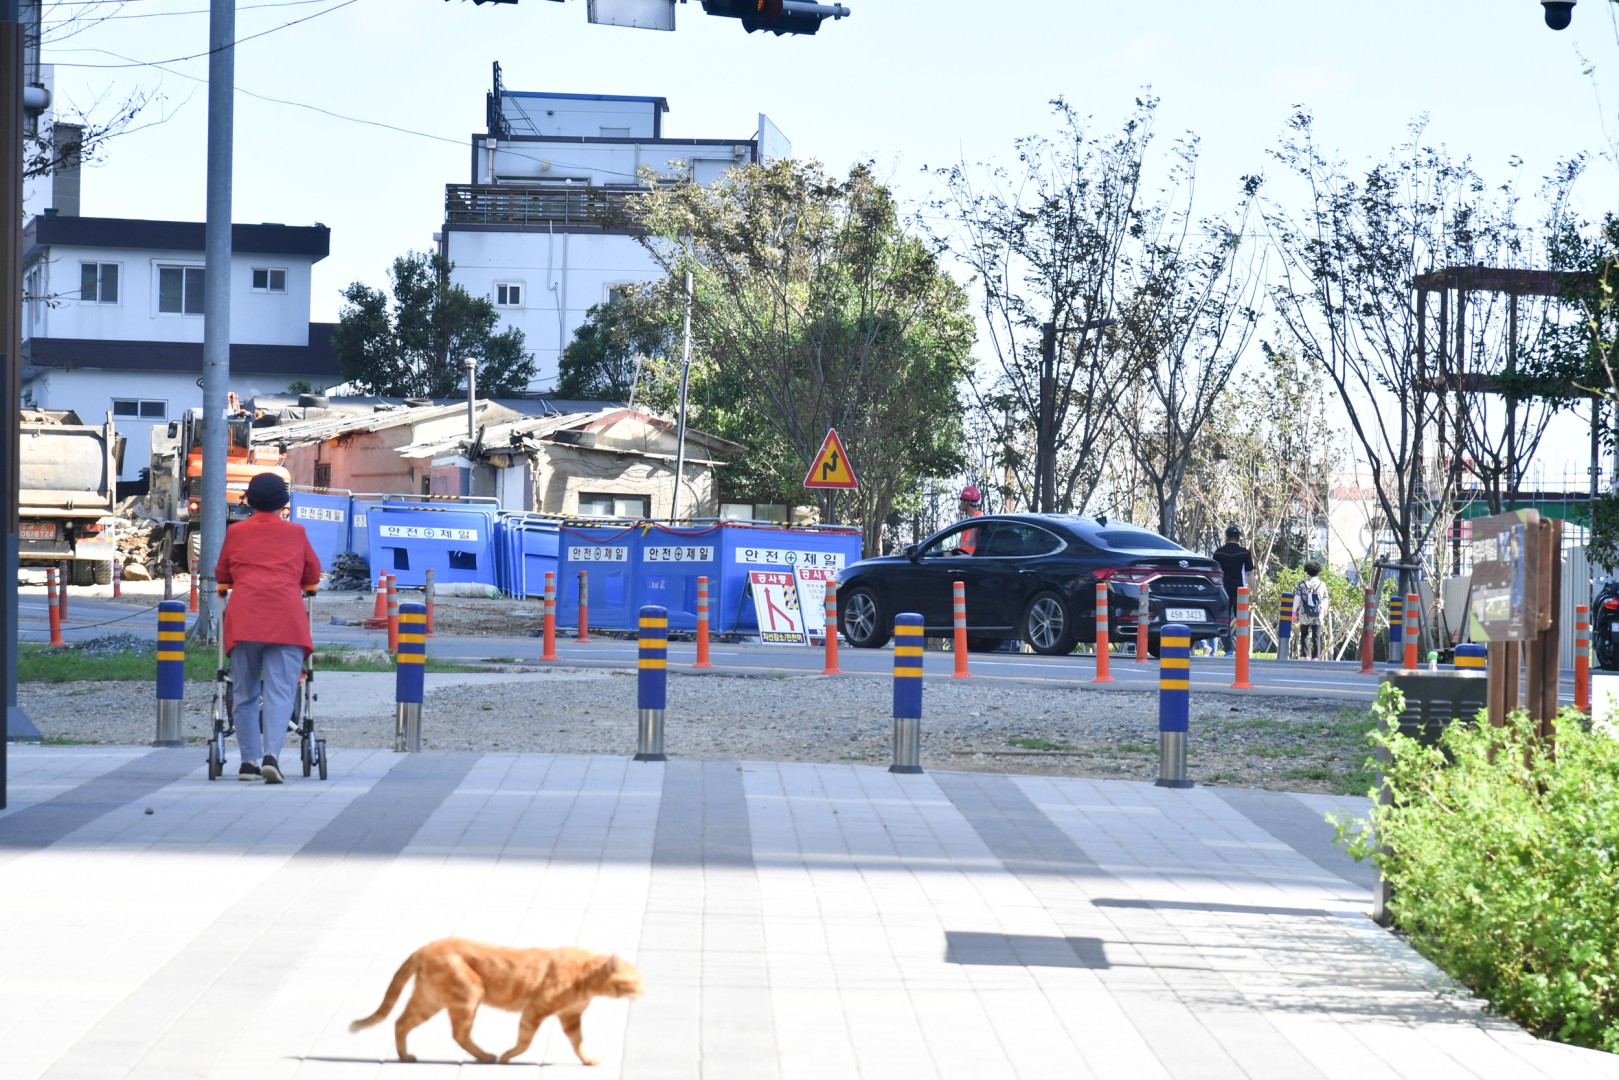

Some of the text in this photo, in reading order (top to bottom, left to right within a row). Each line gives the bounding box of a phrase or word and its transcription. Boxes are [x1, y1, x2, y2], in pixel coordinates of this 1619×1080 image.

[300, 507, 341, 521] 안전 제일
[388, 526, 470, 540] 안전 제일
[572, 547, 624, 561] 안전 제일
[649, 547, 709, 561] 안전 제일
[745, 549, 837, 566] 안전 제일
[757, 574, 787, 583] 공사중
